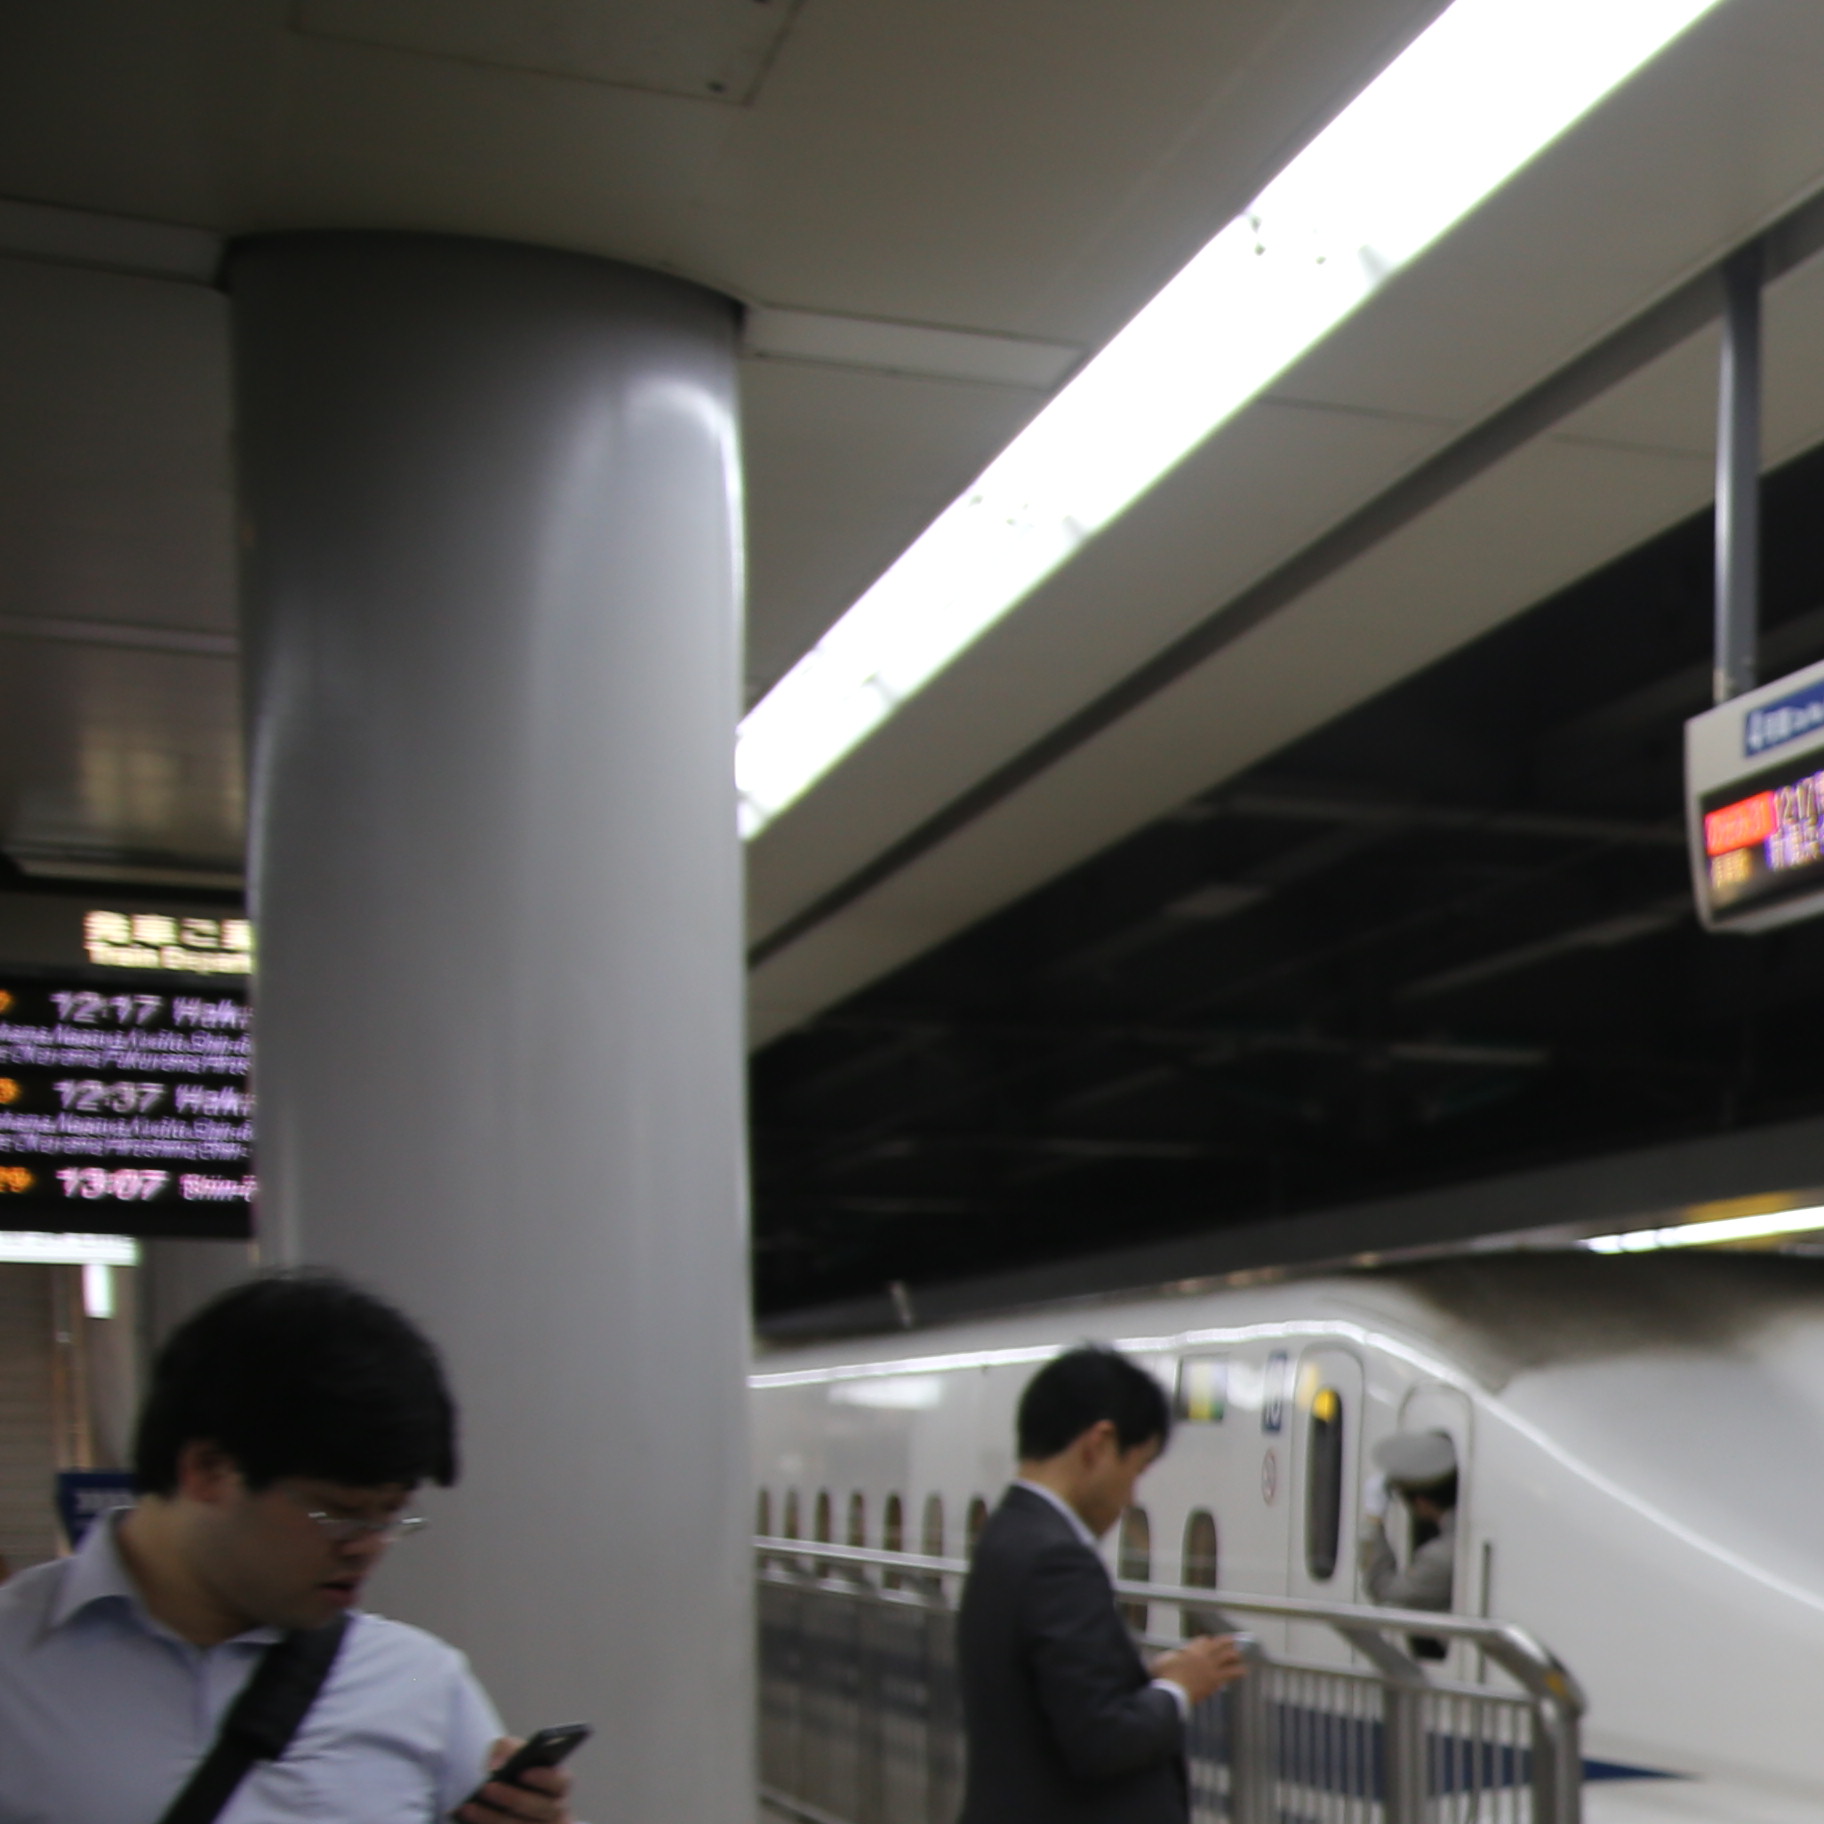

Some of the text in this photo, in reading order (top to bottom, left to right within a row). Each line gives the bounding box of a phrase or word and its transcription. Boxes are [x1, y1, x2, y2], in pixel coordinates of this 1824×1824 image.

[50, 990, 163, 1025] 12:17
[53, 1079, 166, 1113] 12:37
[56, 1167, 169, 1201] 13:07
